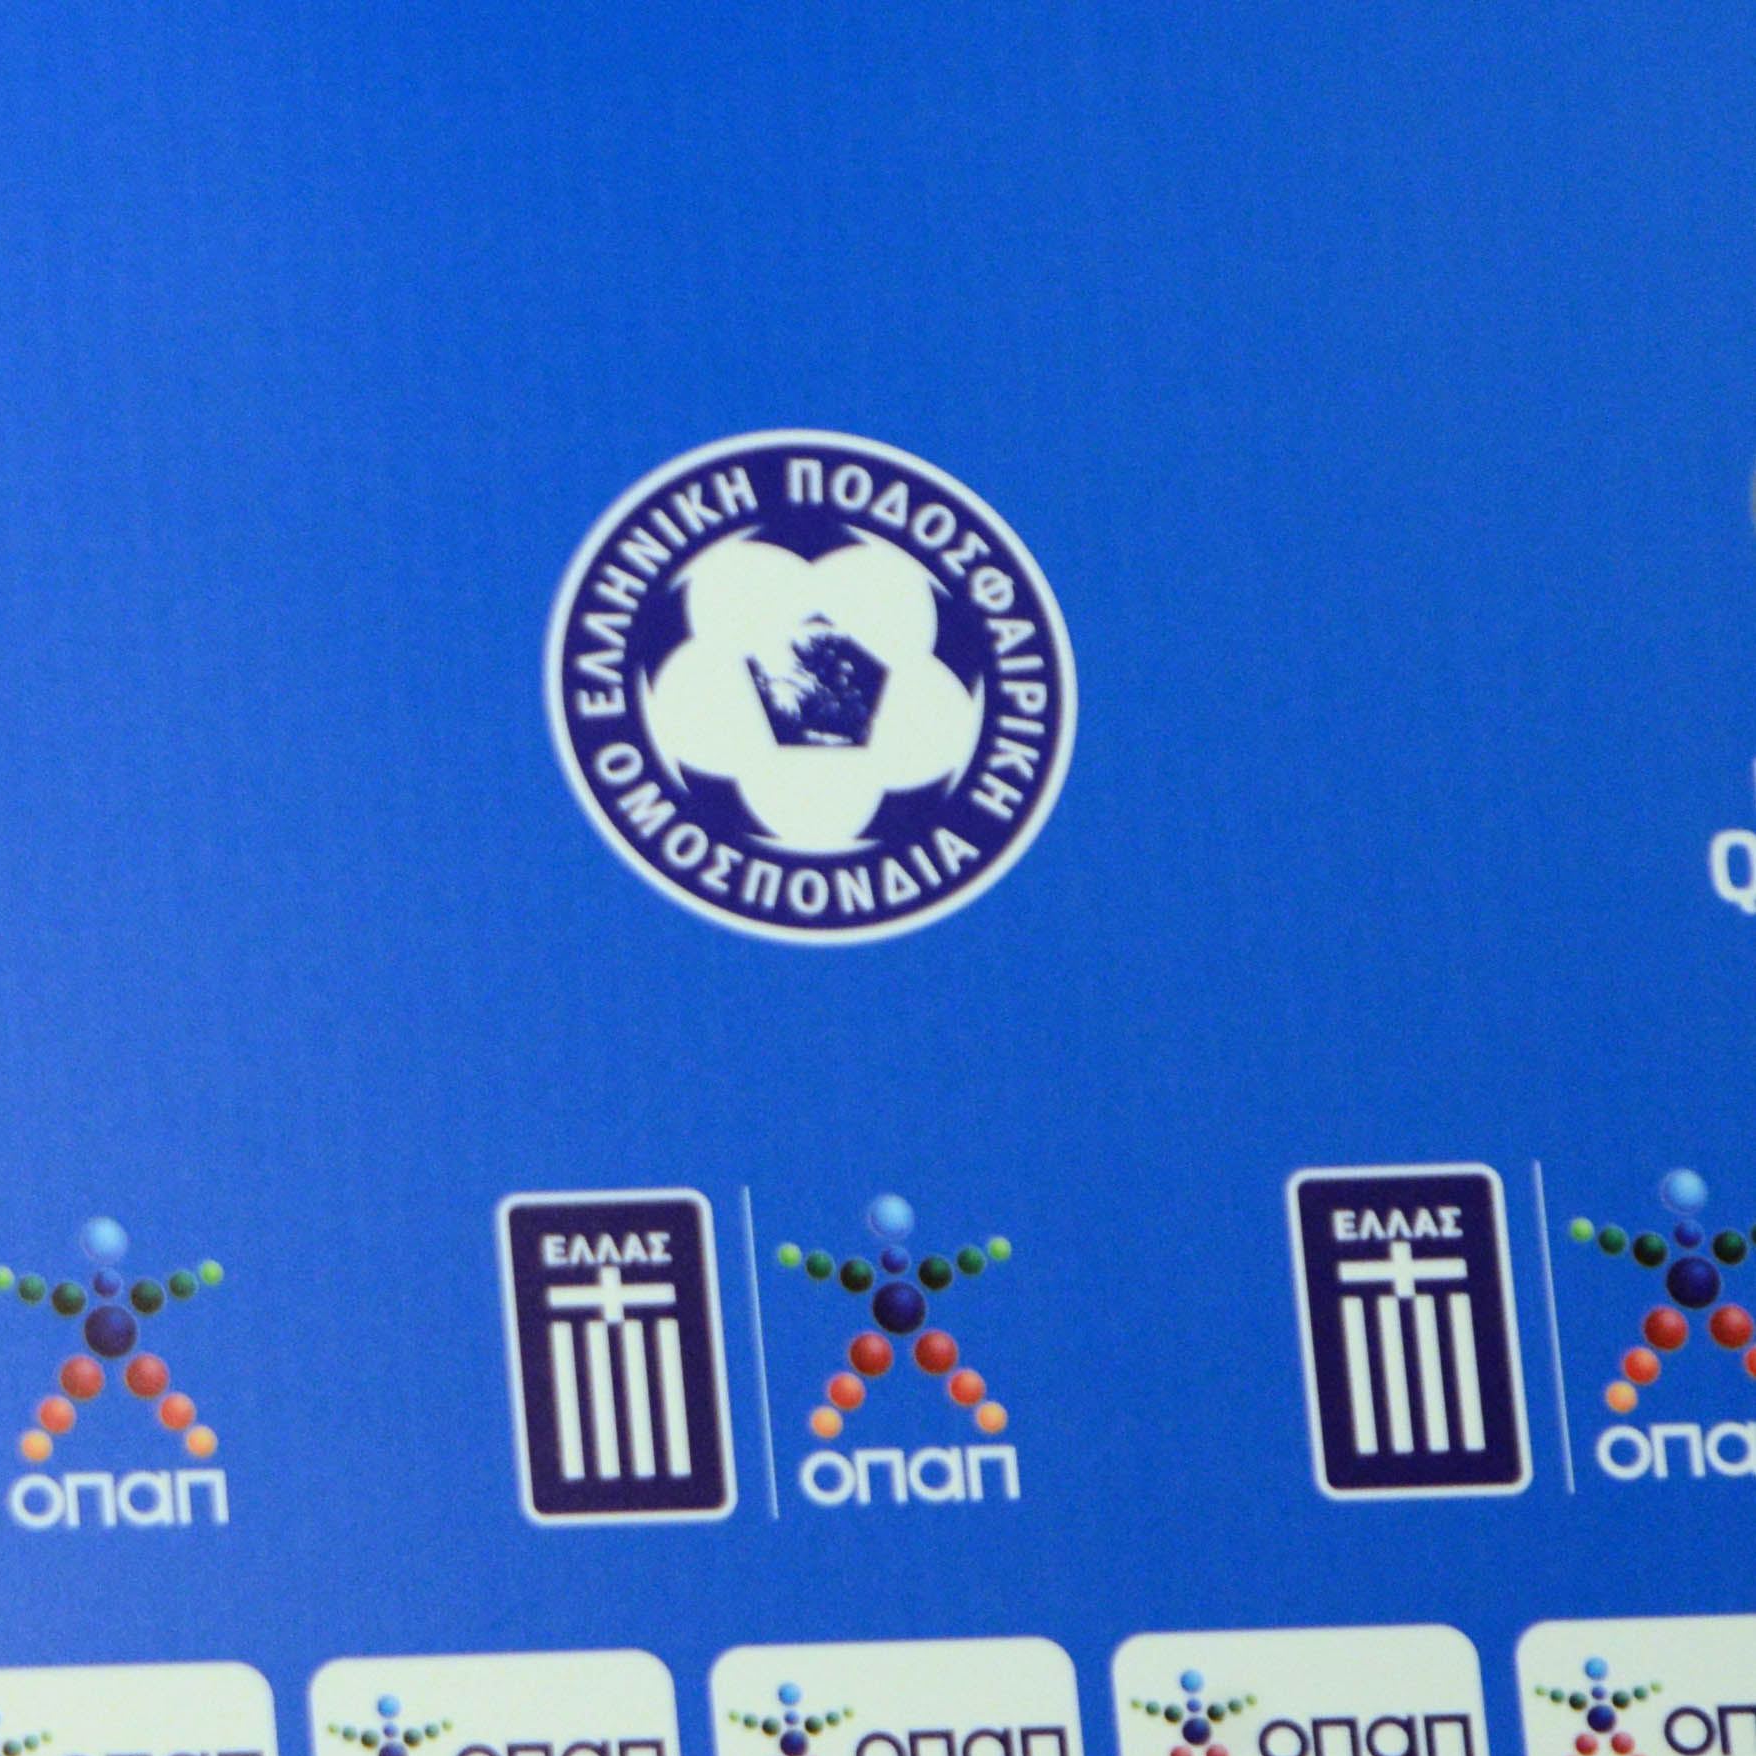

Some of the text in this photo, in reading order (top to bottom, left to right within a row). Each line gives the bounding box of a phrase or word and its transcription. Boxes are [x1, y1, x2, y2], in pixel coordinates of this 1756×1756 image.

[575, 457, 1049, 821] ΕΛΛΗΝΙΚΗ ΠΟΔΟΣΦΑΙΡΙΚΗ
[594, 741, 980, 917] ΟΜΟΣΠΟΝΔΙΑ
[541, 1232, 672, 1267] ΕΛΛΑΣ
[1331, 1207, 1462, 1241] ΕΛΛΑΣ
[1596, 1420, 1756, 1481] οπα
